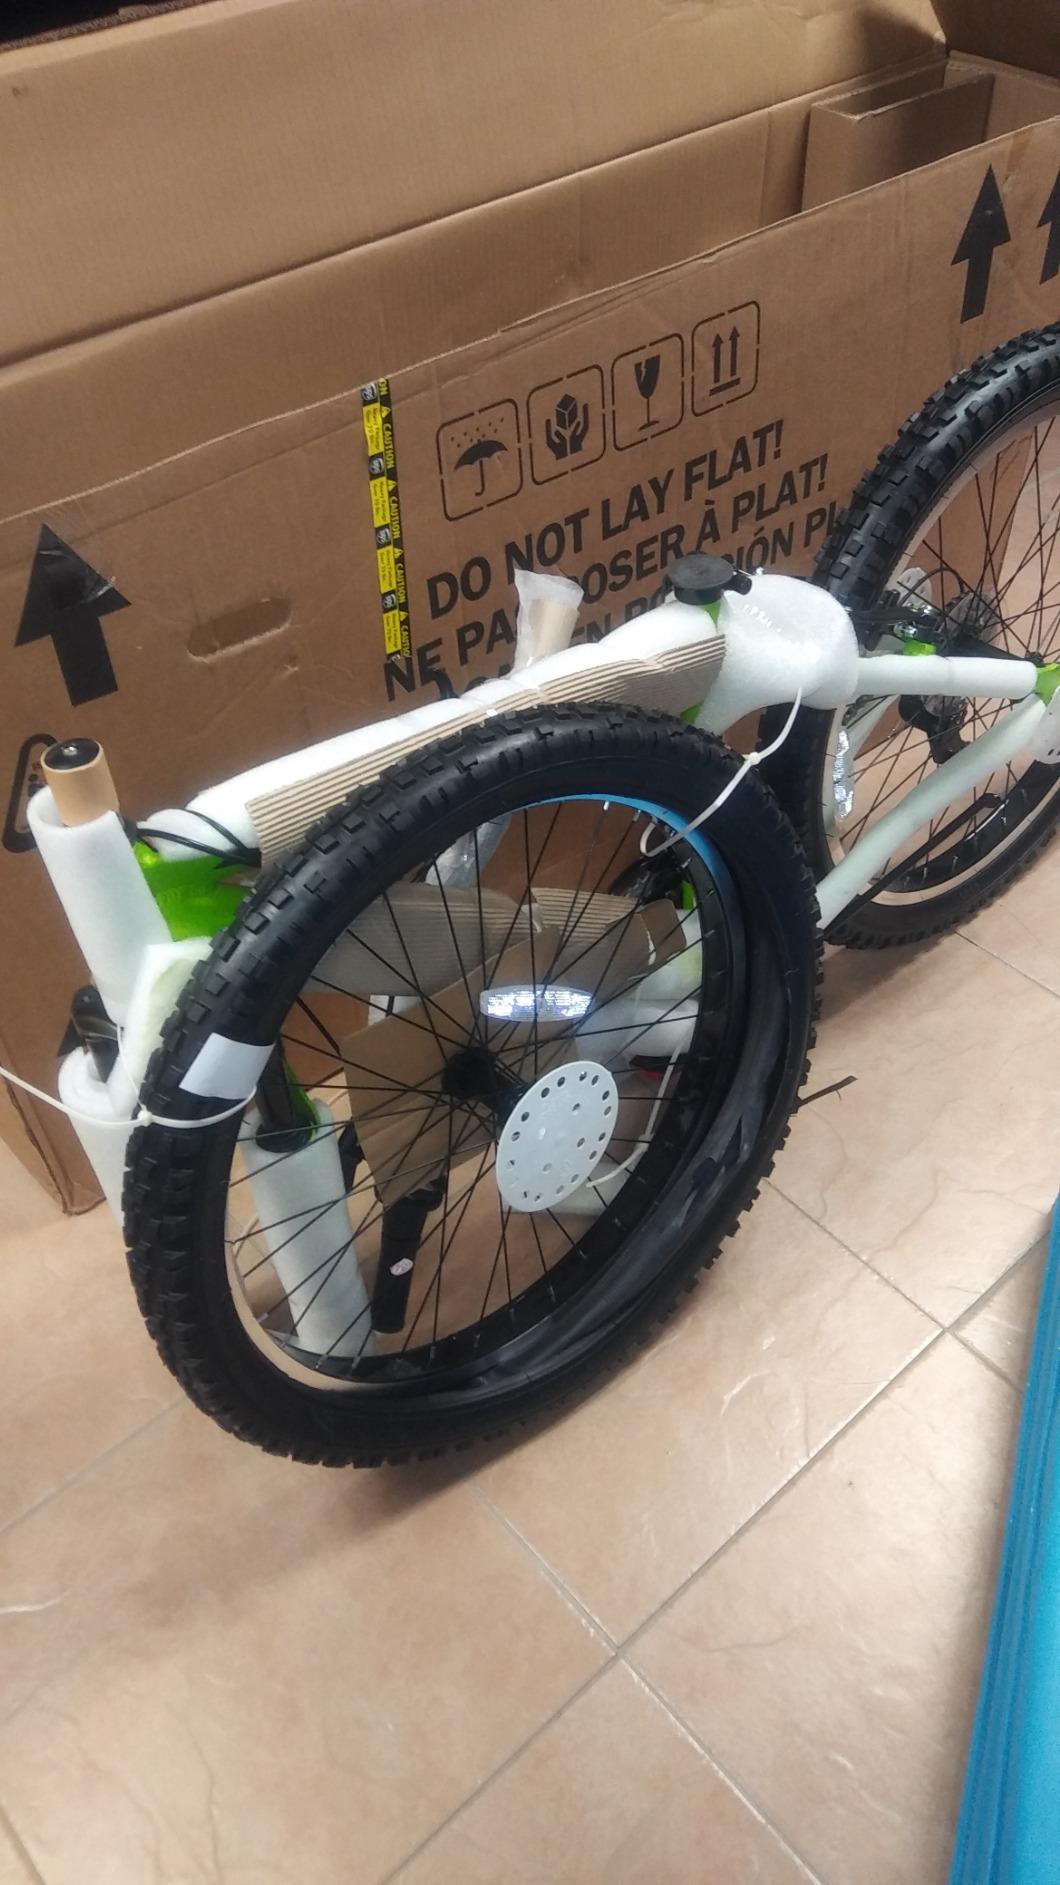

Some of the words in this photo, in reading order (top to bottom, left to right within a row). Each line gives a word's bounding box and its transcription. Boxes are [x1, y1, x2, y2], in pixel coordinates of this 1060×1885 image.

[383, 423, 395, 469] CAUTION
[389, 496, 402, 540] CAUTION
[426, 557, 492, 620] DO
[505, 509, 591, 571] NOT
[601, 469, 674, 542] LAY
[684, 419, 784, 501] FLAT!
[384, 637, 442, 702] NE
[456, 608, 518, 667] PA
[568, 524, 685, 604] OSER
[696, 499, 721, 552] À
[731, 453, 828, 534] PLAT!
[395, 563, 406, 604] CAUTION
[401, 625, 411, 657] CAUTIO
